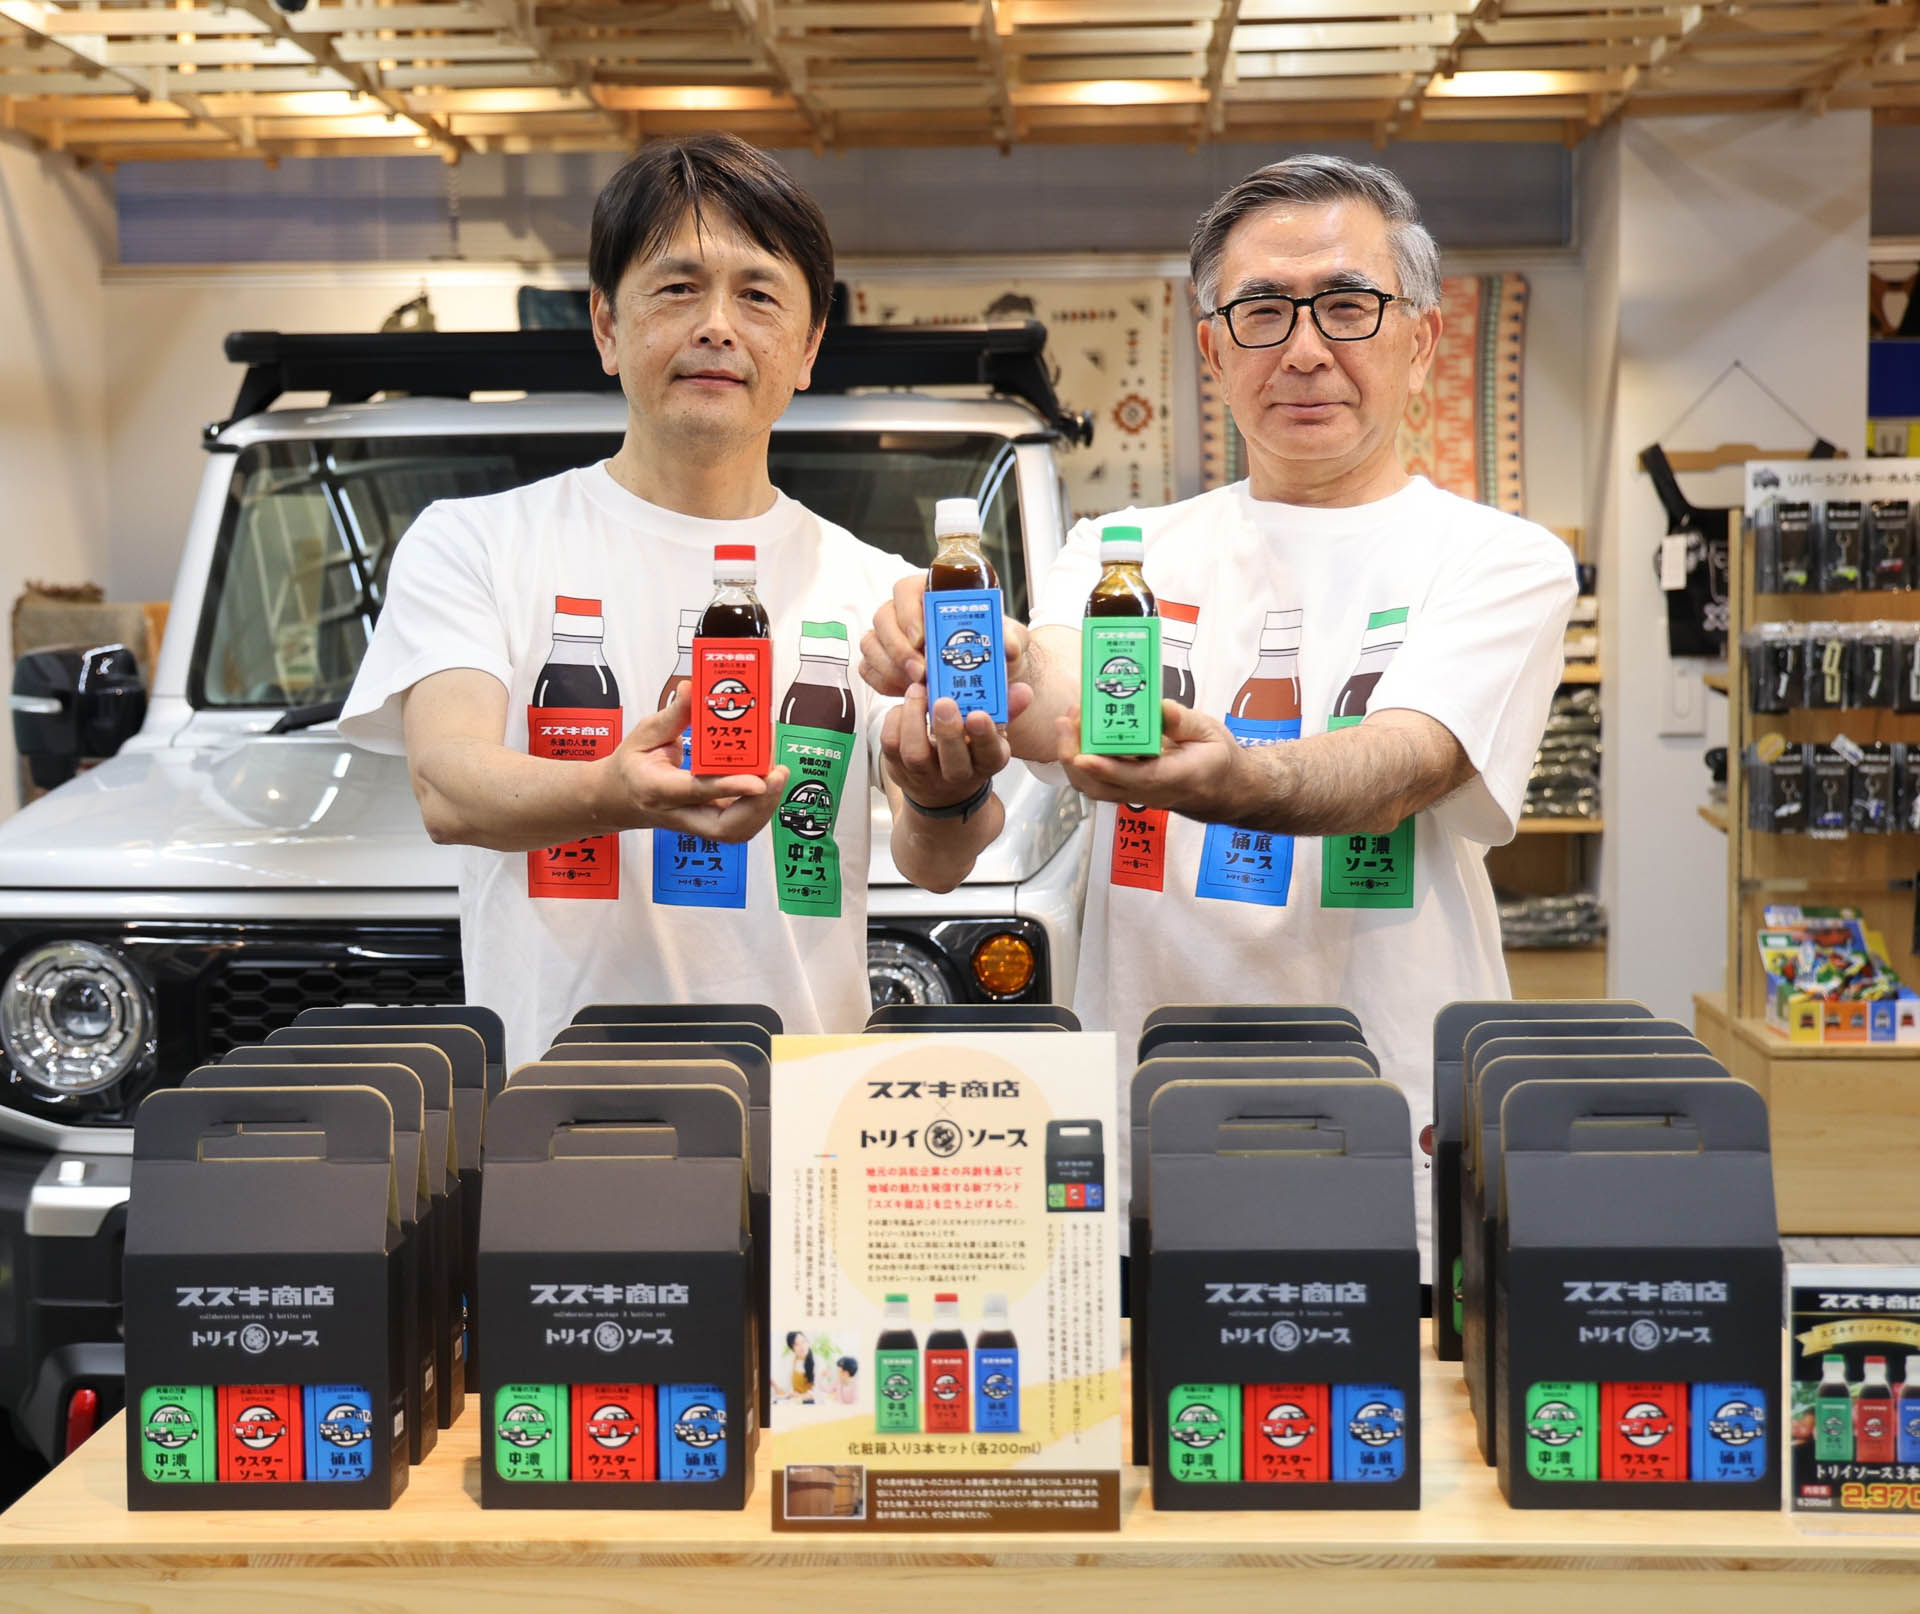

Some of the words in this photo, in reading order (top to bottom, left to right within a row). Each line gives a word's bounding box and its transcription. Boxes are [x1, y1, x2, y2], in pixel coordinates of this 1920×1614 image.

[951, 689, 987, 700] ソース
[1103, 718, 1139, 729] ソース
[540, 726, 609, 737] スズキ商店
[707, 726, 752, 737] ウスター
[712, 740, 747, 750] ソース
[552, 748, 596, 757] CAPPUCCINO
[1118, 817, 1155, 834] ウスター
[1119, 838, 1152, 854] ソース
[547, 847, 597, 863] ソース
[1225, 851, 1273, 871] ソース
[674, 856, 724, 872] ソース
[1346, 857, 1395, 872] ソース
[784, 864, 826, 882] ソース
[867, 1080, 1021, 1099] スズキ商店
[860, 1128, 920, 1149] トリイ
[968, 1128, 1029, 1148] ソース
[176, 1284, 335, 1307] スズキ商店
[530, 1283, 689, 1305] スズキ商店
[1204, 1282, 1368, 1304] スズキ商店
[1563, 1280, 1728, 1302] スズキ商店
[192, 1330, 238, 1347] トリイ
[272, 1330, 320, 1346] ソース
[546, 1328, 592, 1345] トリイ
[626, 1328, 674, 1344] ソース
[1220, 1328, 1267, 1344] トリイ
[1303, 1328, 1351, 1344] ソース
[1578, 1326, 1626, 1344] トリイ
[1662, 1326, 1712, 1344] ソース
[235, 1456, 283, 1467] ウスター
[588, 1455, 636, 1466] ウスター
[1262, 1454, 1312, 1464] ウスター
[1620, 1454, 1670, 1464] ウスター
[154, 1468, 192, 1480] ソース
[240, 1469, 278, 1480] ソース
[328, 1467, 366, 1479] ソース
[507, 1468, 544, 1480] ソース
[593, 1468, 630, 1480] ソース
[682, 1468, 720, 1478] ソース
[1180, 1468, 1218, 1480] ソース
[1268, 1468, 1306, 1480] ソース
[1357, 1466, 1396, 1478] ソース
[1536, 1466, 1575, 1478] ソース
[1626, 1467, 1664, 1478] ソース
[1716, 1466, 1756, 1478] ソース
